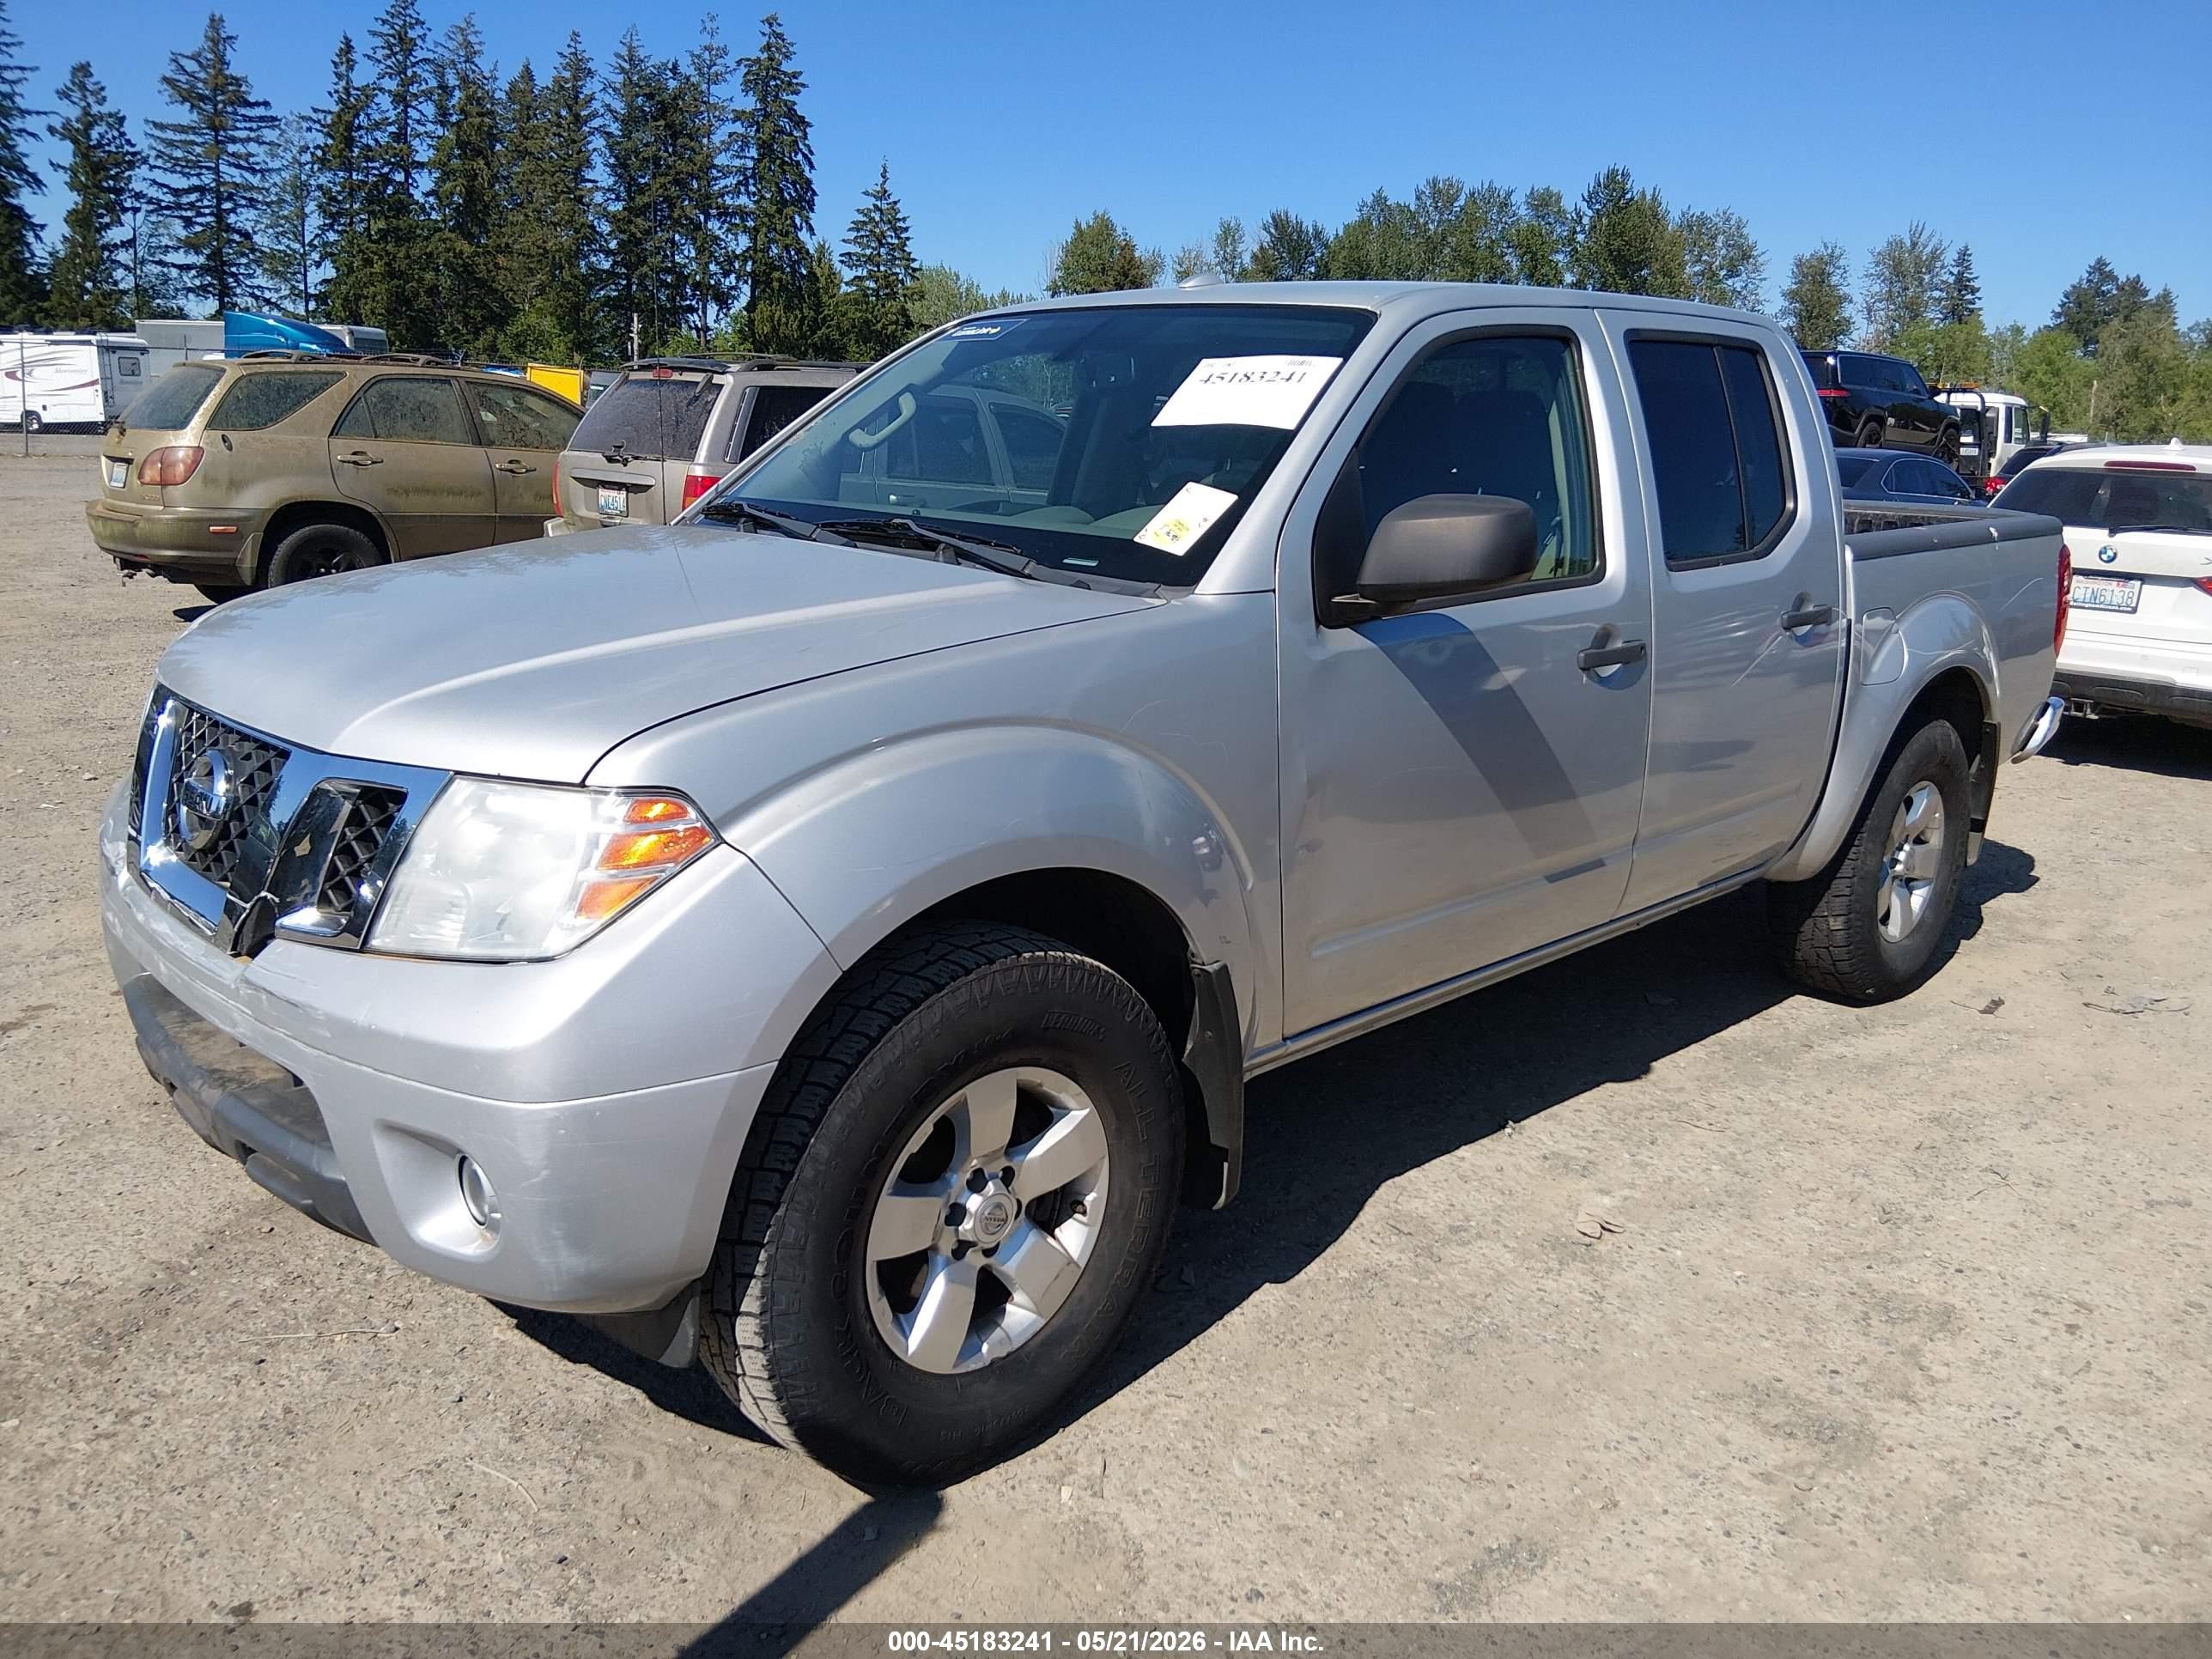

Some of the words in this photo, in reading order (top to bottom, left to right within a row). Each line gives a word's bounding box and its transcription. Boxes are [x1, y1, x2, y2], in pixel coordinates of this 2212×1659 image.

[1199, 371, 1307, 384] 45183241
[2072, 586, 2135, 606] CTN6138
[1112, 1060, 1154, 1141] ALL
